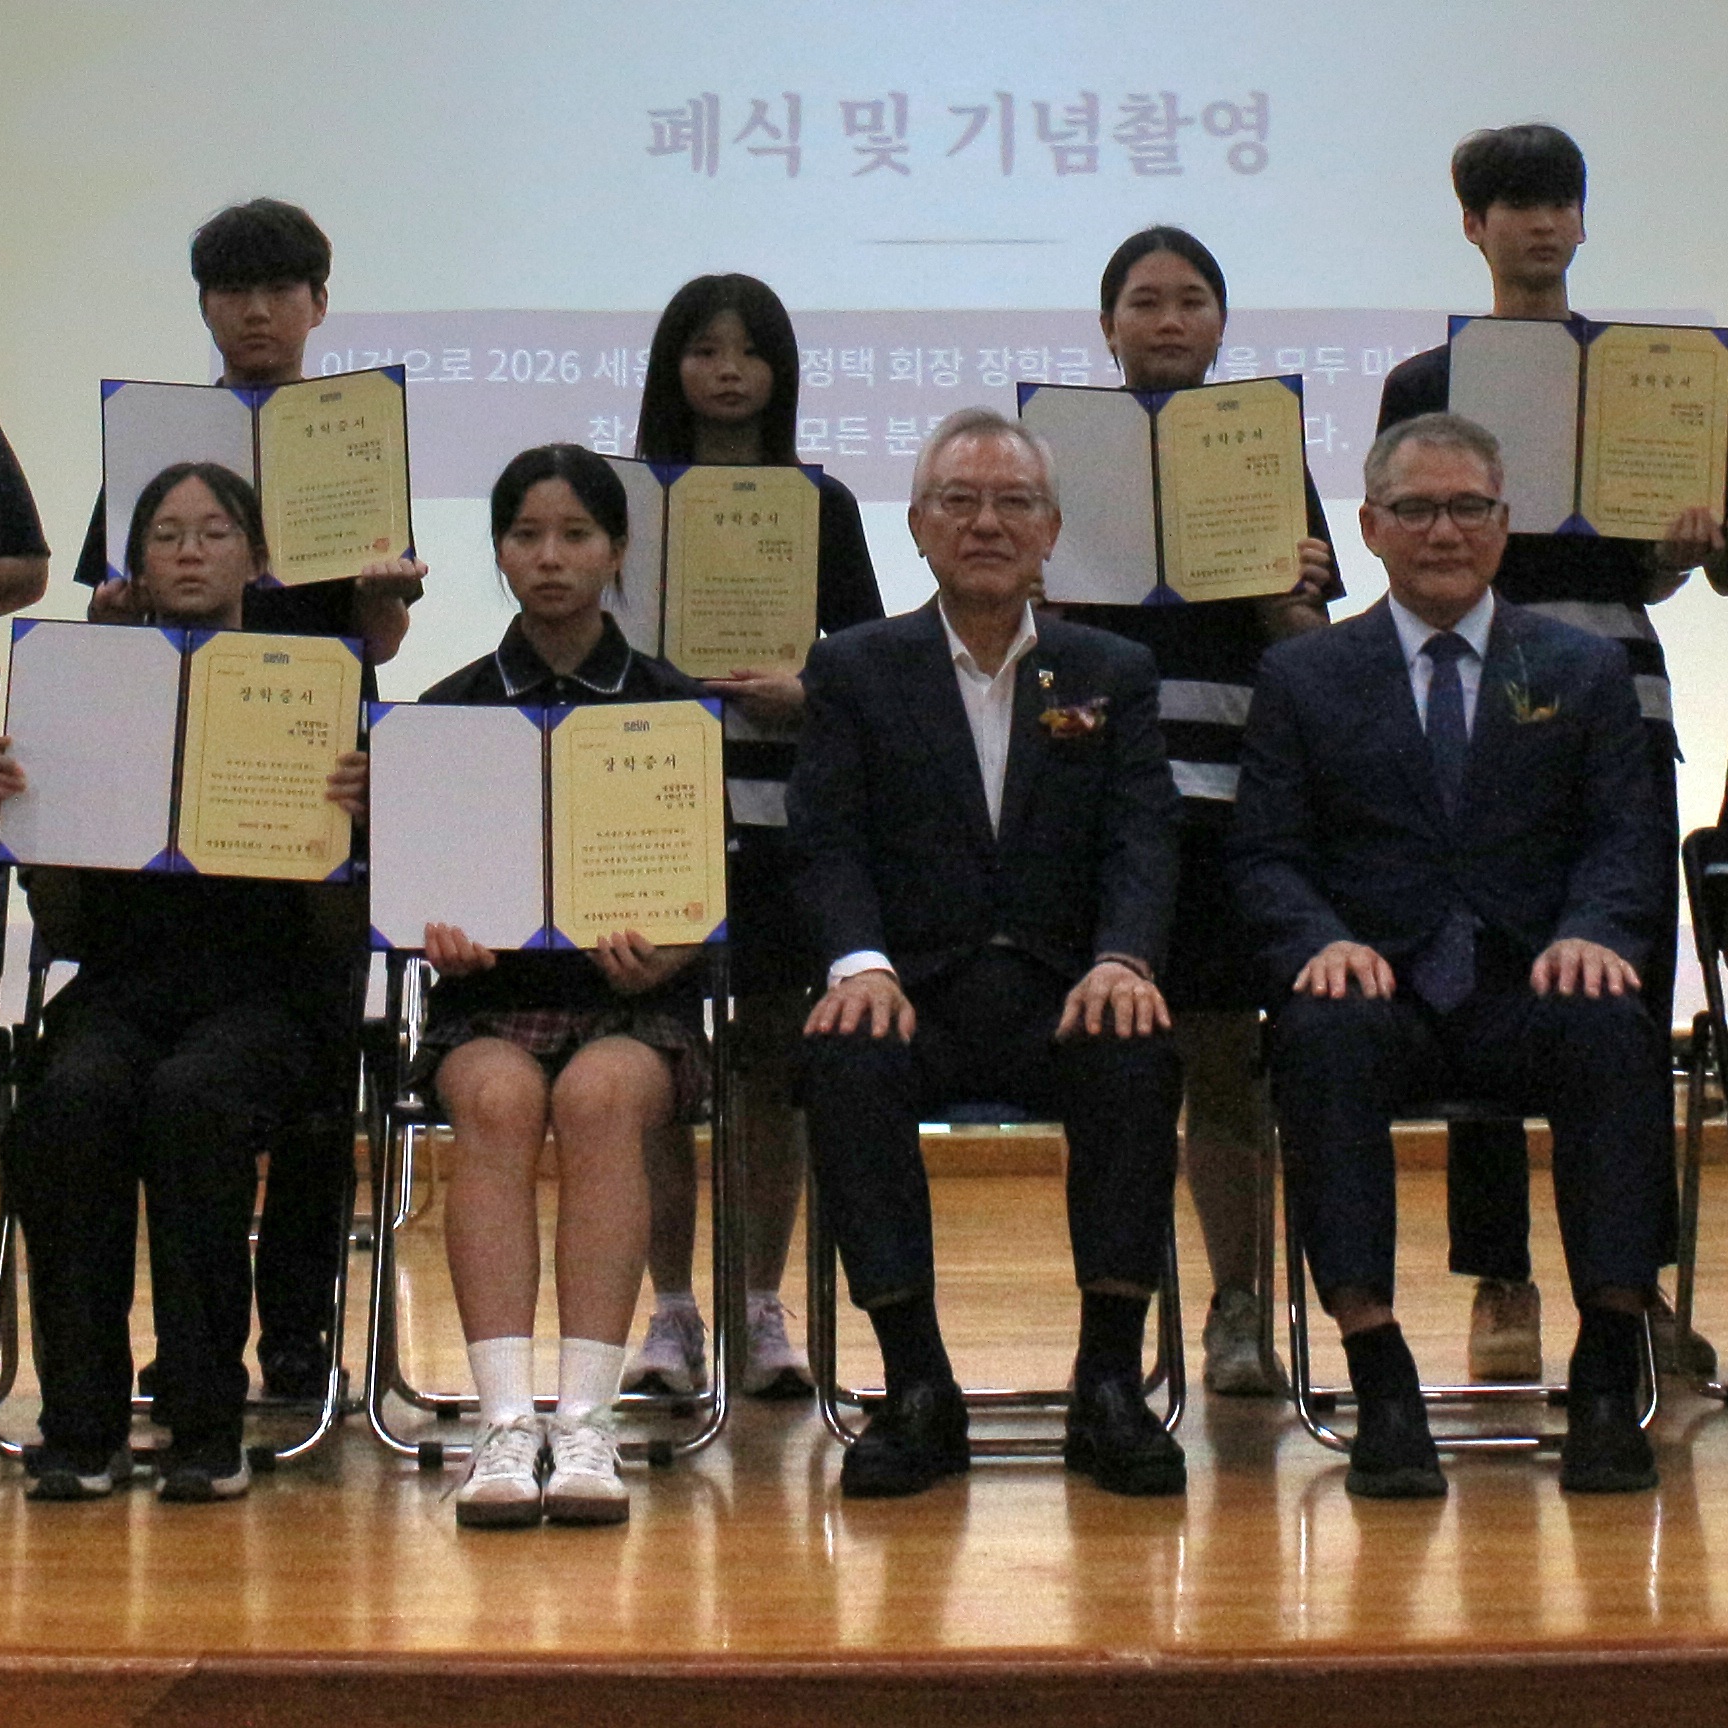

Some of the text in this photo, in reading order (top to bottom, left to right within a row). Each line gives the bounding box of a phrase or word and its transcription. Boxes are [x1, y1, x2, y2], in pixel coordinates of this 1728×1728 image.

[645, 90, 1271, 177] 폐식 및 기념촬영
[484, 349, 581, 384] 2026
[800, 347, 874, 388] 정택
[889, 347, 964, 387] 회장
